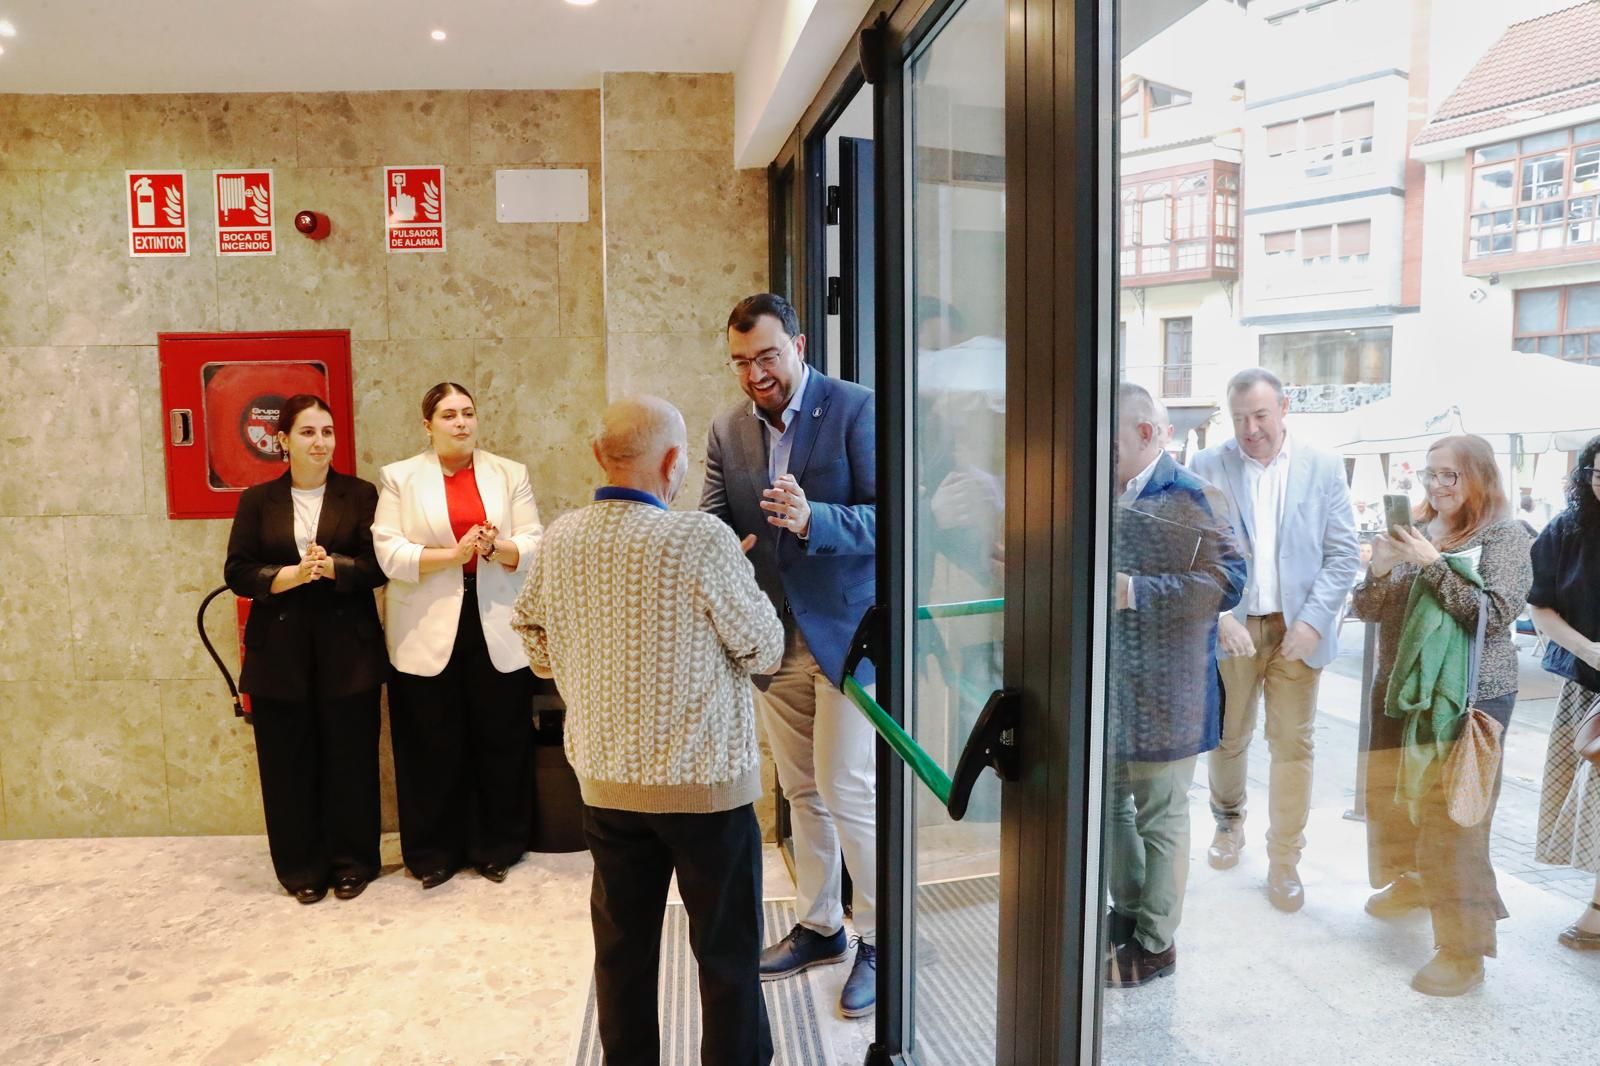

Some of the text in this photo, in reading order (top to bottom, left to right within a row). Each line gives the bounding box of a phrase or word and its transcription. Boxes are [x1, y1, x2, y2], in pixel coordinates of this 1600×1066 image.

[222, 232, 268, 241] BOCA DE
[393, 229, 438, 237] PULSADOR
[134, 235, 184, 250] EXTINTOR
[221, 241, 270, 250] INCENDIO
[391, 238, 440, 247] DE ALARMA
